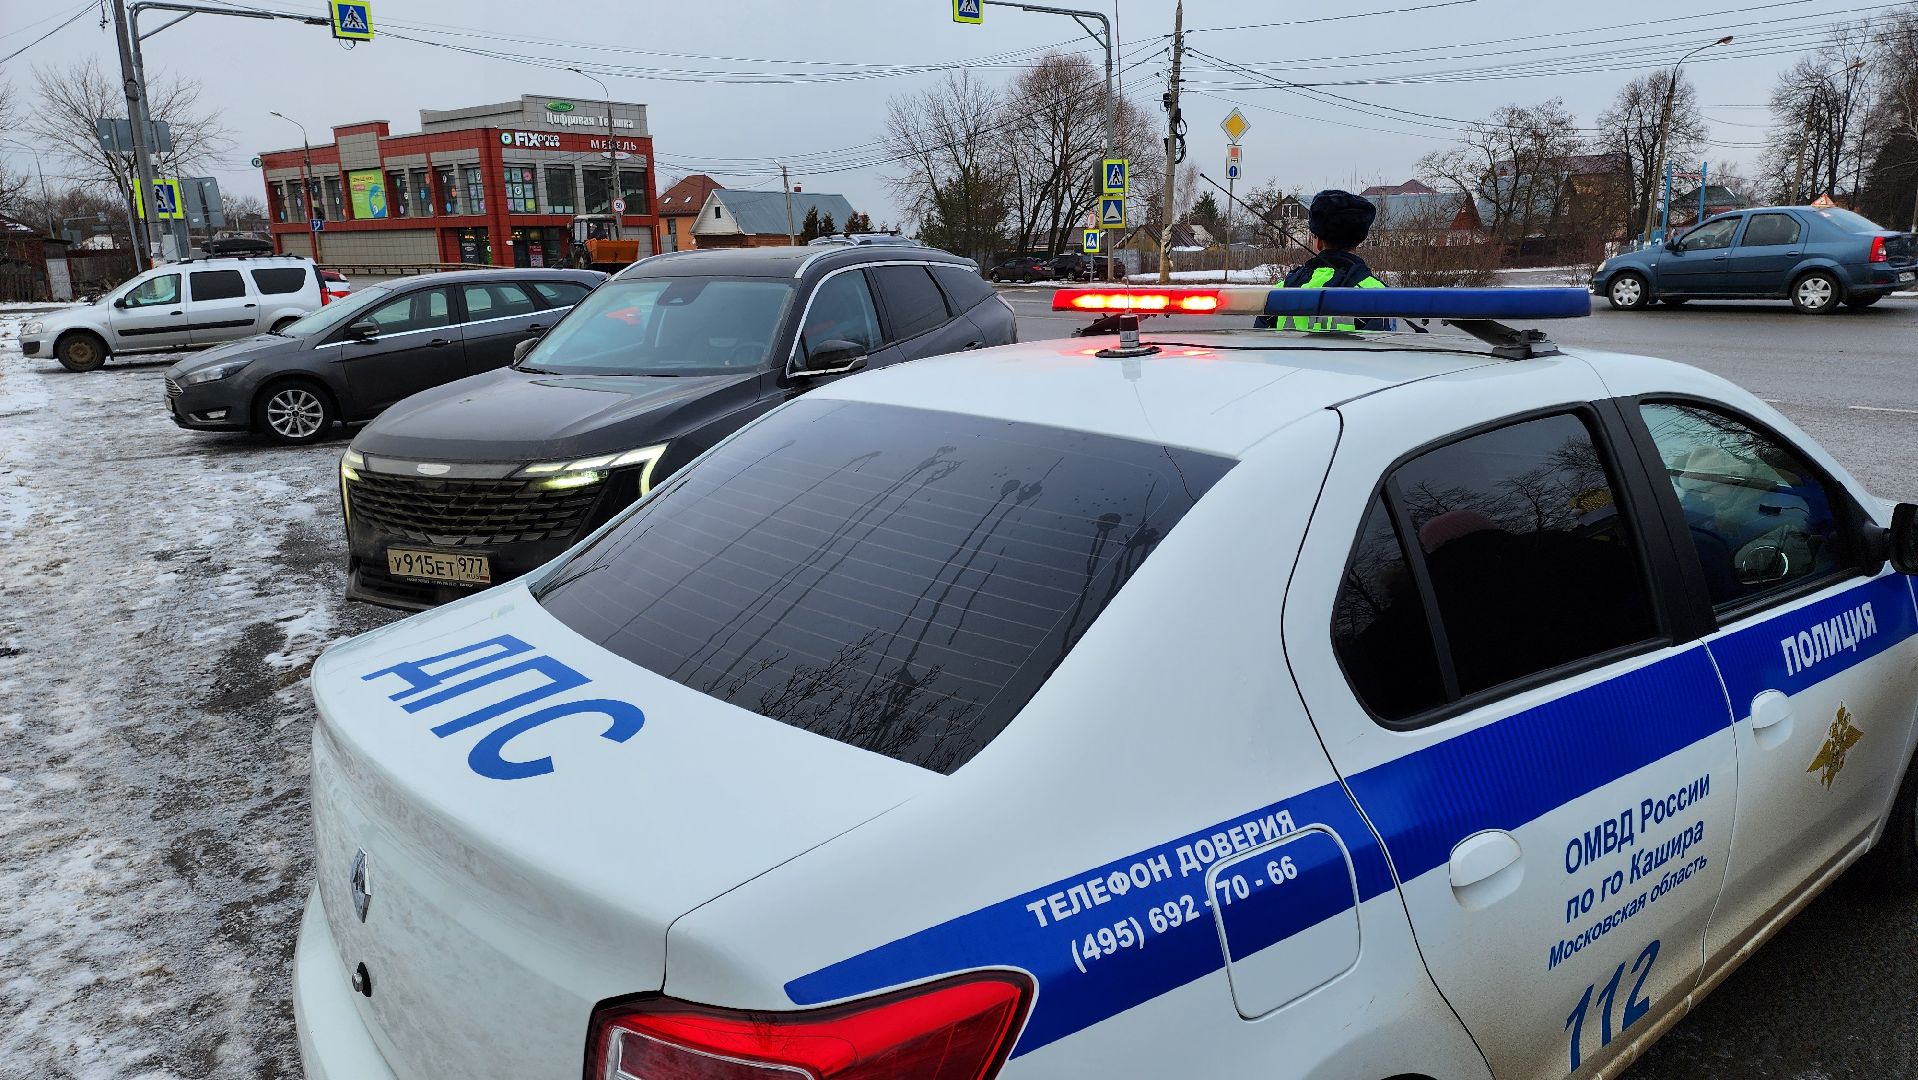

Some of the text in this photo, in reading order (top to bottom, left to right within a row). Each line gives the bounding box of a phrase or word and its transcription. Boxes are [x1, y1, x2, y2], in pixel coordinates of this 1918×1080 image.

[546, 112, 594, 126] Цифровая
[393, 553, 483, 577] У915ЕТ 977
[1780, 601, 1878, 677] ПОЛИЦИЯ
[361, 634, 645, 780] ДПС
[1026, 809, 1296, 928] ТЕЛЕФОН ДОВЕРИЯ
[1565, 773, 1710, 874] ОМВД России
[1566, 820, 1704, 923] по го Кашира
[1071, 916, 1145, 973] (495)
[1148, 894, 1200, 934] 692
[1215, 874, 1250, 905] 70
[1266, 855, 1298, 885] 66
[1548, 855, 1708, 971] Московская область
[1563, 940, 1661, 1074] 112
